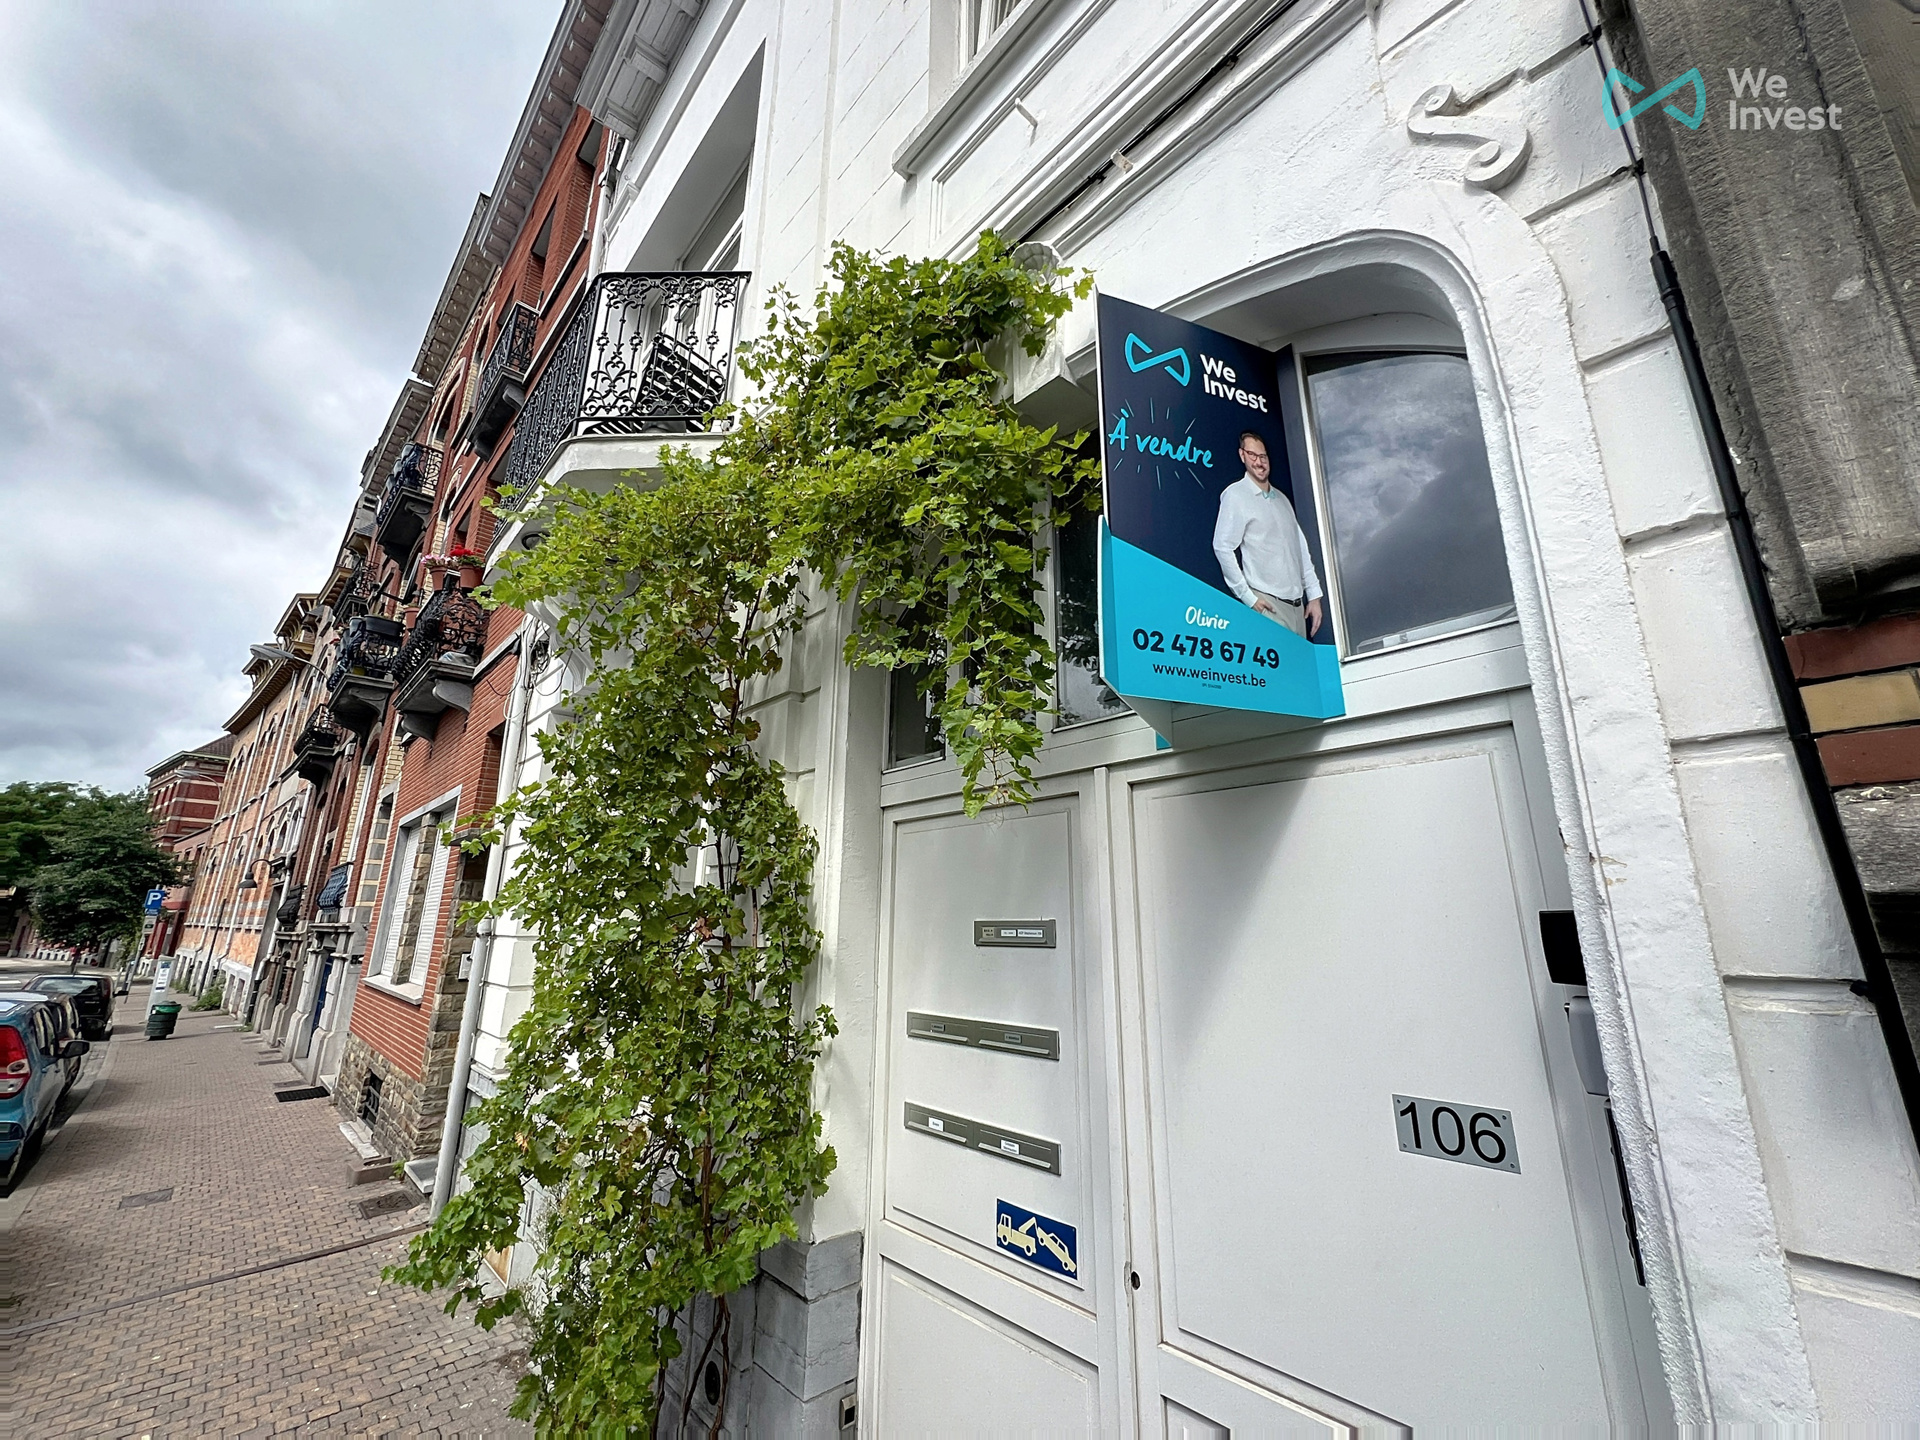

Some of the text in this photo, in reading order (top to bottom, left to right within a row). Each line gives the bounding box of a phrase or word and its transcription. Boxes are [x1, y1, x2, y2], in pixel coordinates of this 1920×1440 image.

[1200, 354, 1236, 383] We
[1203, 374, 1268, 413] Invest
[1108, 408, 1214, 468] À vendre
[1185, 605, 1230, 630] Olivier
[1133, 628, 1280, 670] 02 478 67 49
[1153, 662, 1267, 688] www.weinvest.be
[147, 892, 162, 906] P
[1400, 1101, 1506, 1164] 106
